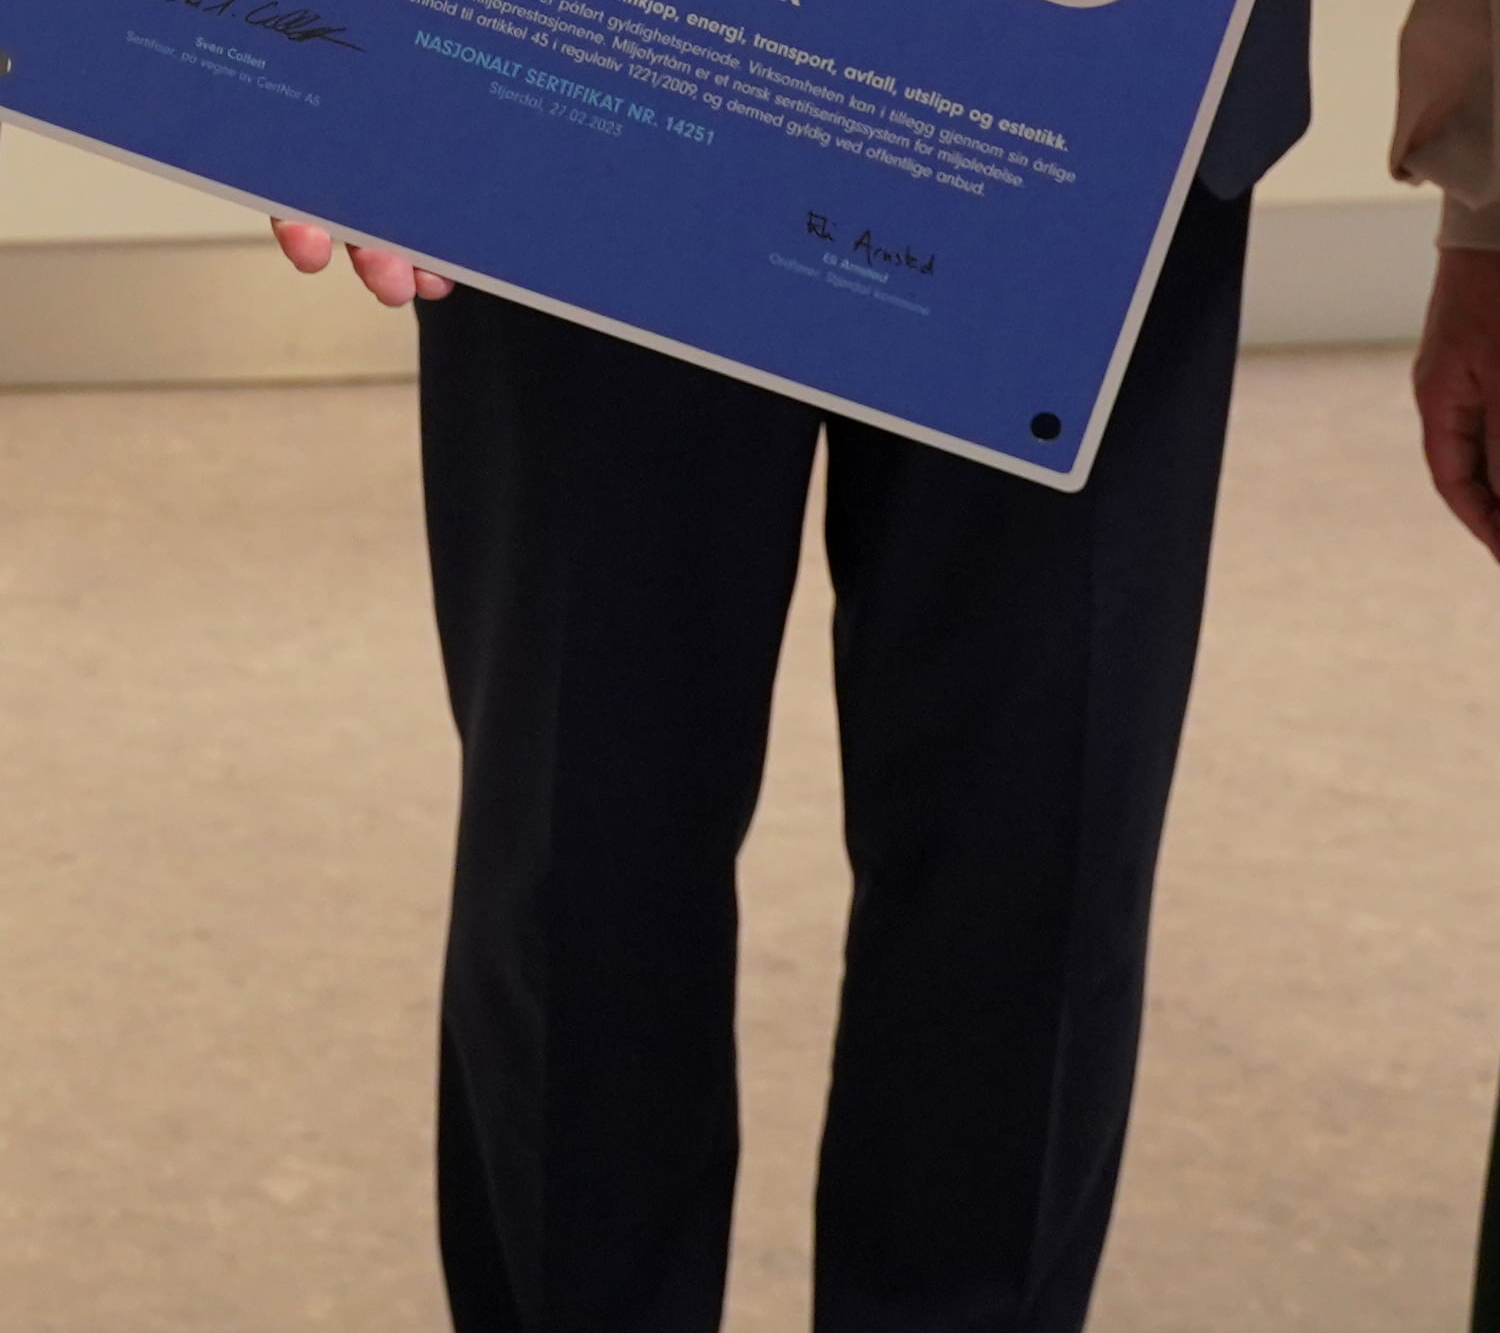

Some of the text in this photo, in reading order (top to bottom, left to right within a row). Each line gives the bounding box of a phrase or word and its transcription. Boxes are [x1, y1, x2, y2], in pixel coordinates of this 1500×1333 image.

[413, 28, 523, 78] NASJONALT
[523, 66, 625, 114] SERTIFIKAT
[665, 115, 715, 146] 14251
[902, 85, 965, 118] utslipp
[967, 107, 994, 130] og
